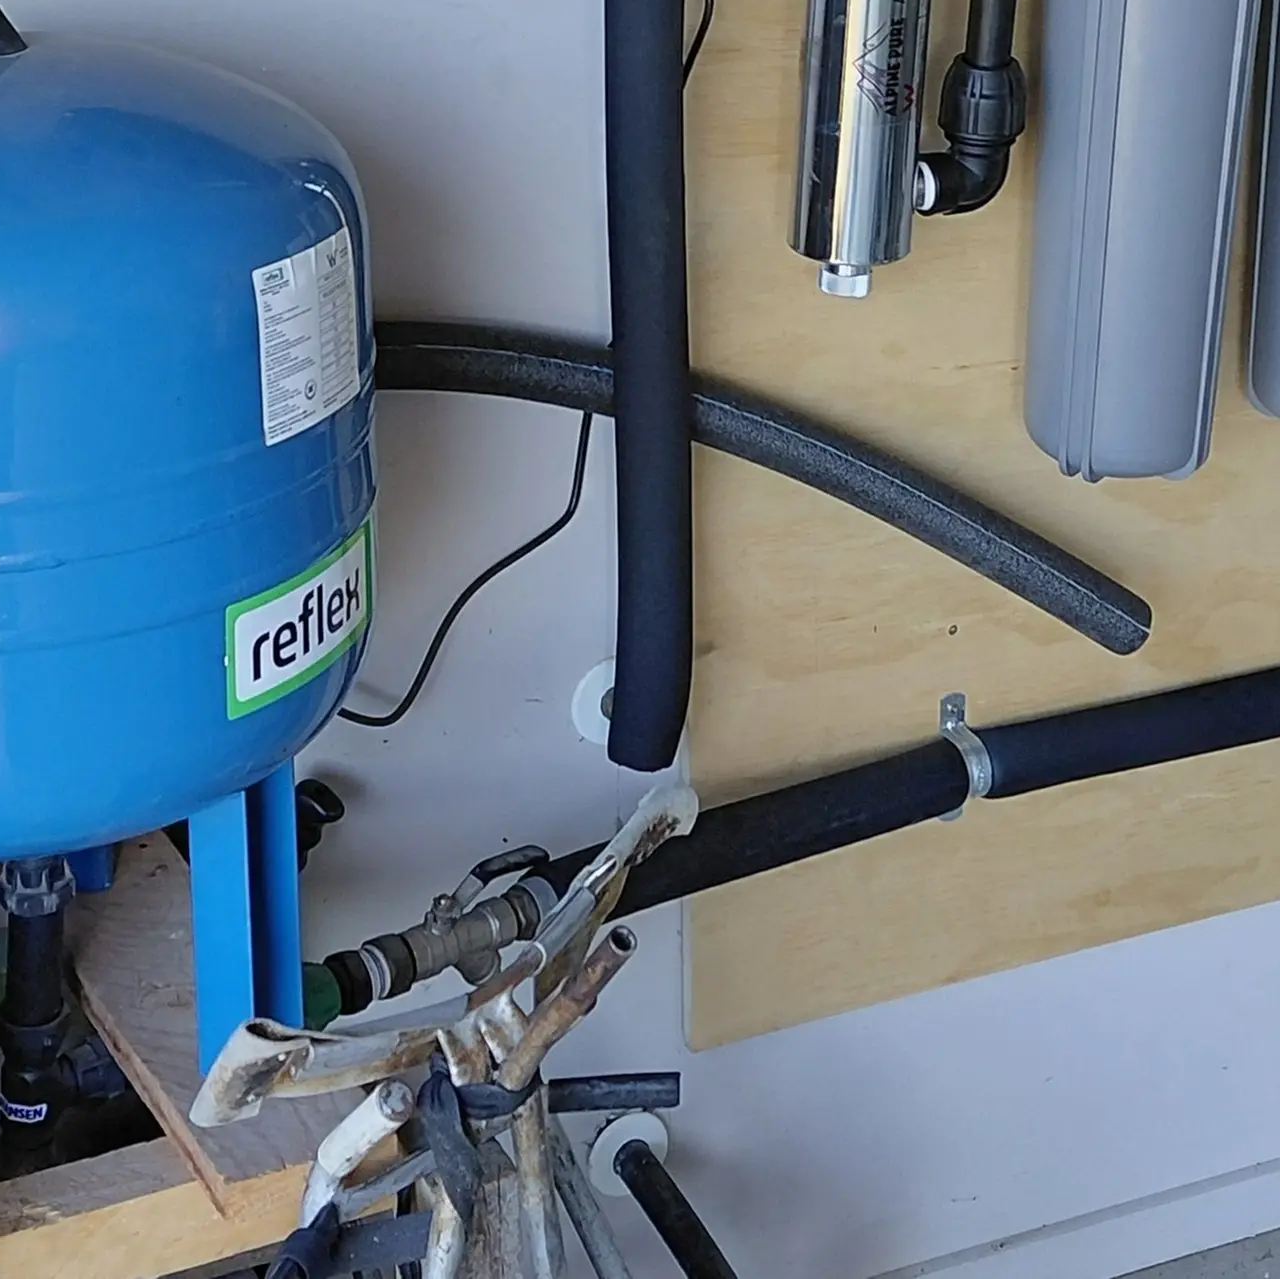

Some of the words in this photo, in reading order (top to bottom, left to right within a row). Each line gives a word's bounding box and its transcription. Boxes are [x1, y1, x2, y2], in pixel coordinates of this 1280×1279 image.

[888, 17, 905, 60] PURE
[883, 61, 901, 117] ALPINE
[252, 567, 361, 683] reflex
